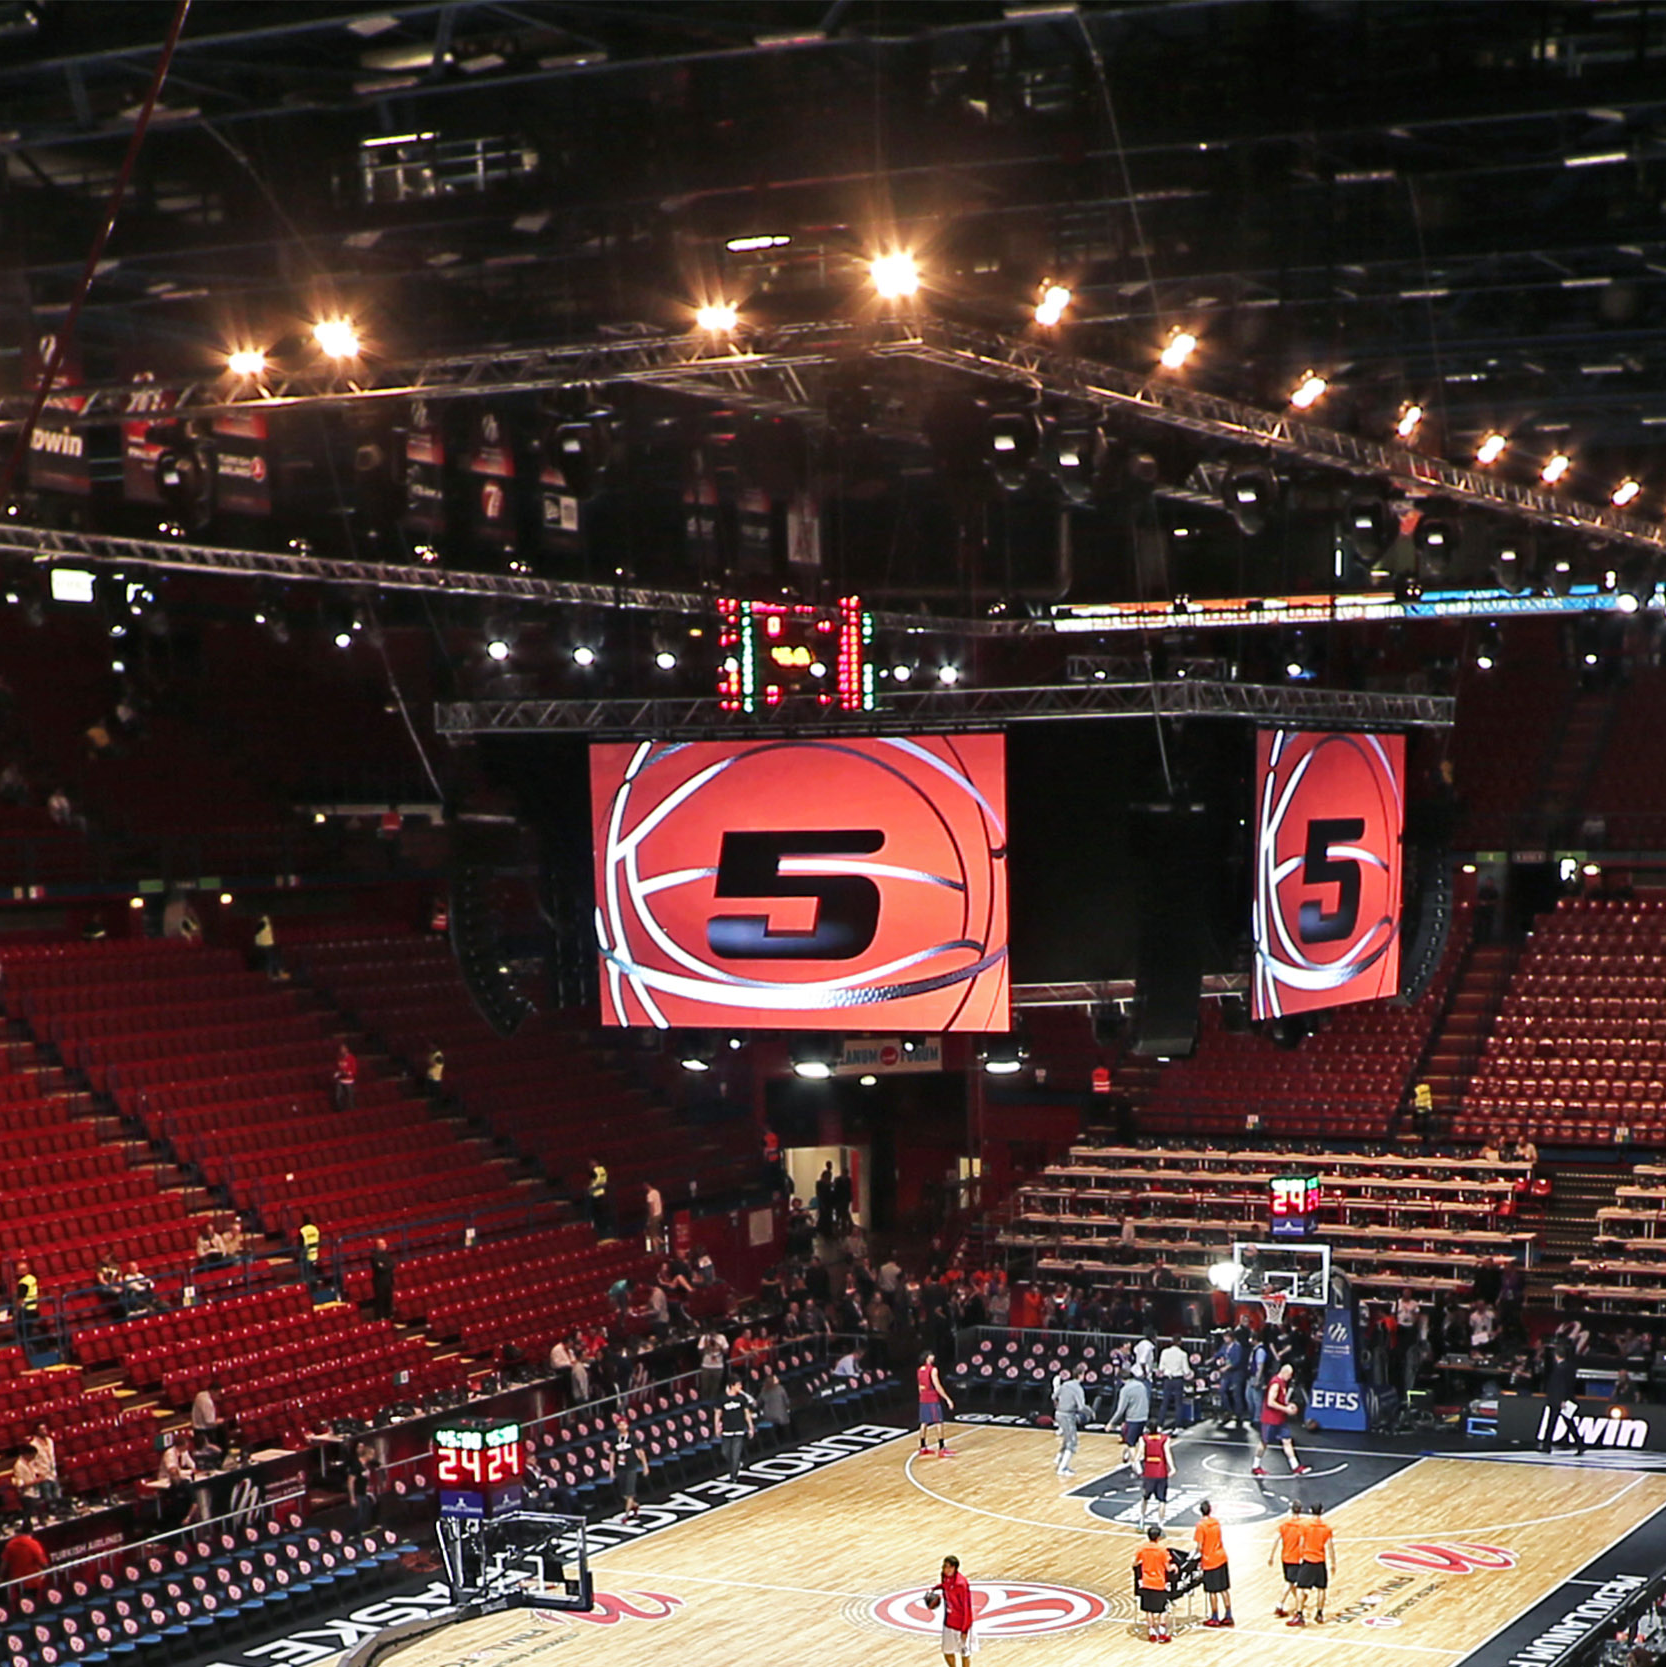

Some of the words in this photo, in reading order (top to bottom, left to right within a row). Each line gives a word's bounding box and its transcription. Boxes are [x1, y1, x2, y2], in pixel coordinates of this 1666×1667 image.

[707, 829, 886, 960] 5
[1299, 817, 1365, 944] 5
[1311, 1389, 1360, 1412] EFES
[437, 1448, 482, 1483] 24
[486, 1442, 520, 1482] 24
[1517, 1574, 1648, 1661] MEDIOLANUM
